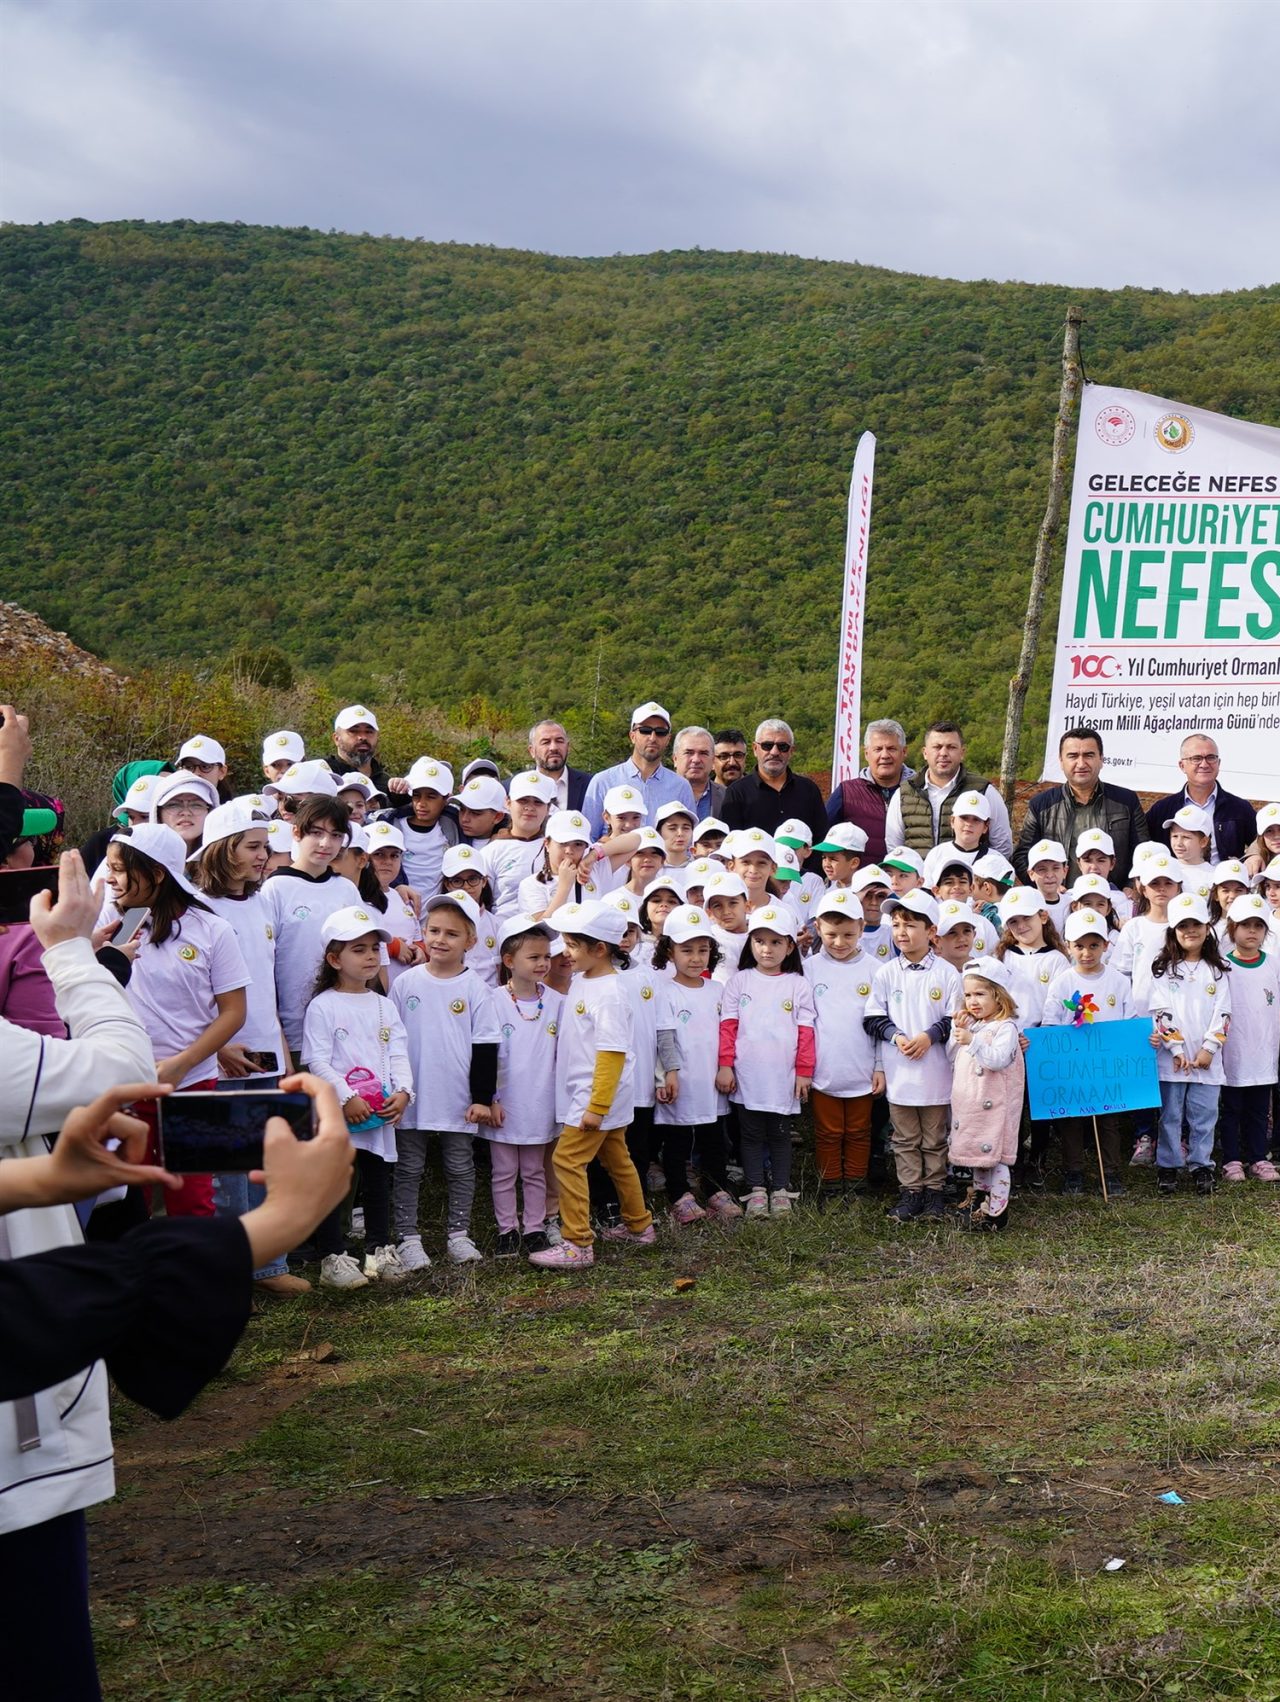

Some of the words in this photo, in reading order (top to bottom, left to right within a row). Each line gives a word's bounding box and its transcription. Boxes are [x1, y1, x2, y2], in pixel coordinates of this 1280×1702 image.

[1088, 471, 1200, 492] GELECEĞE
[1208, 475, 1278, 493] NEFES
[1128, 657, 1145, 677] Yıl
[1147, 657, 1228, 680] Cumhuriyet
[1065, 692, 1098, 712] Haydi
[1100, 692, 1145, 712] Türkiye,
[1148, 692, 1176, 712] yeşil
[1178, 693, 1211, 708] vatan
[1213, 692, 1234, 711] için
[1236, 691, 1259, 710] hep
[1064, 715, 1075, 731] 11
[1116, 714, 1142, 731] Milli
[1143, 713, 1224, 734] Ağaçlandırma
[1083, 1027, 1112, 1053] YIL
[1041, 1081, 1124, 1107] ORMANI
